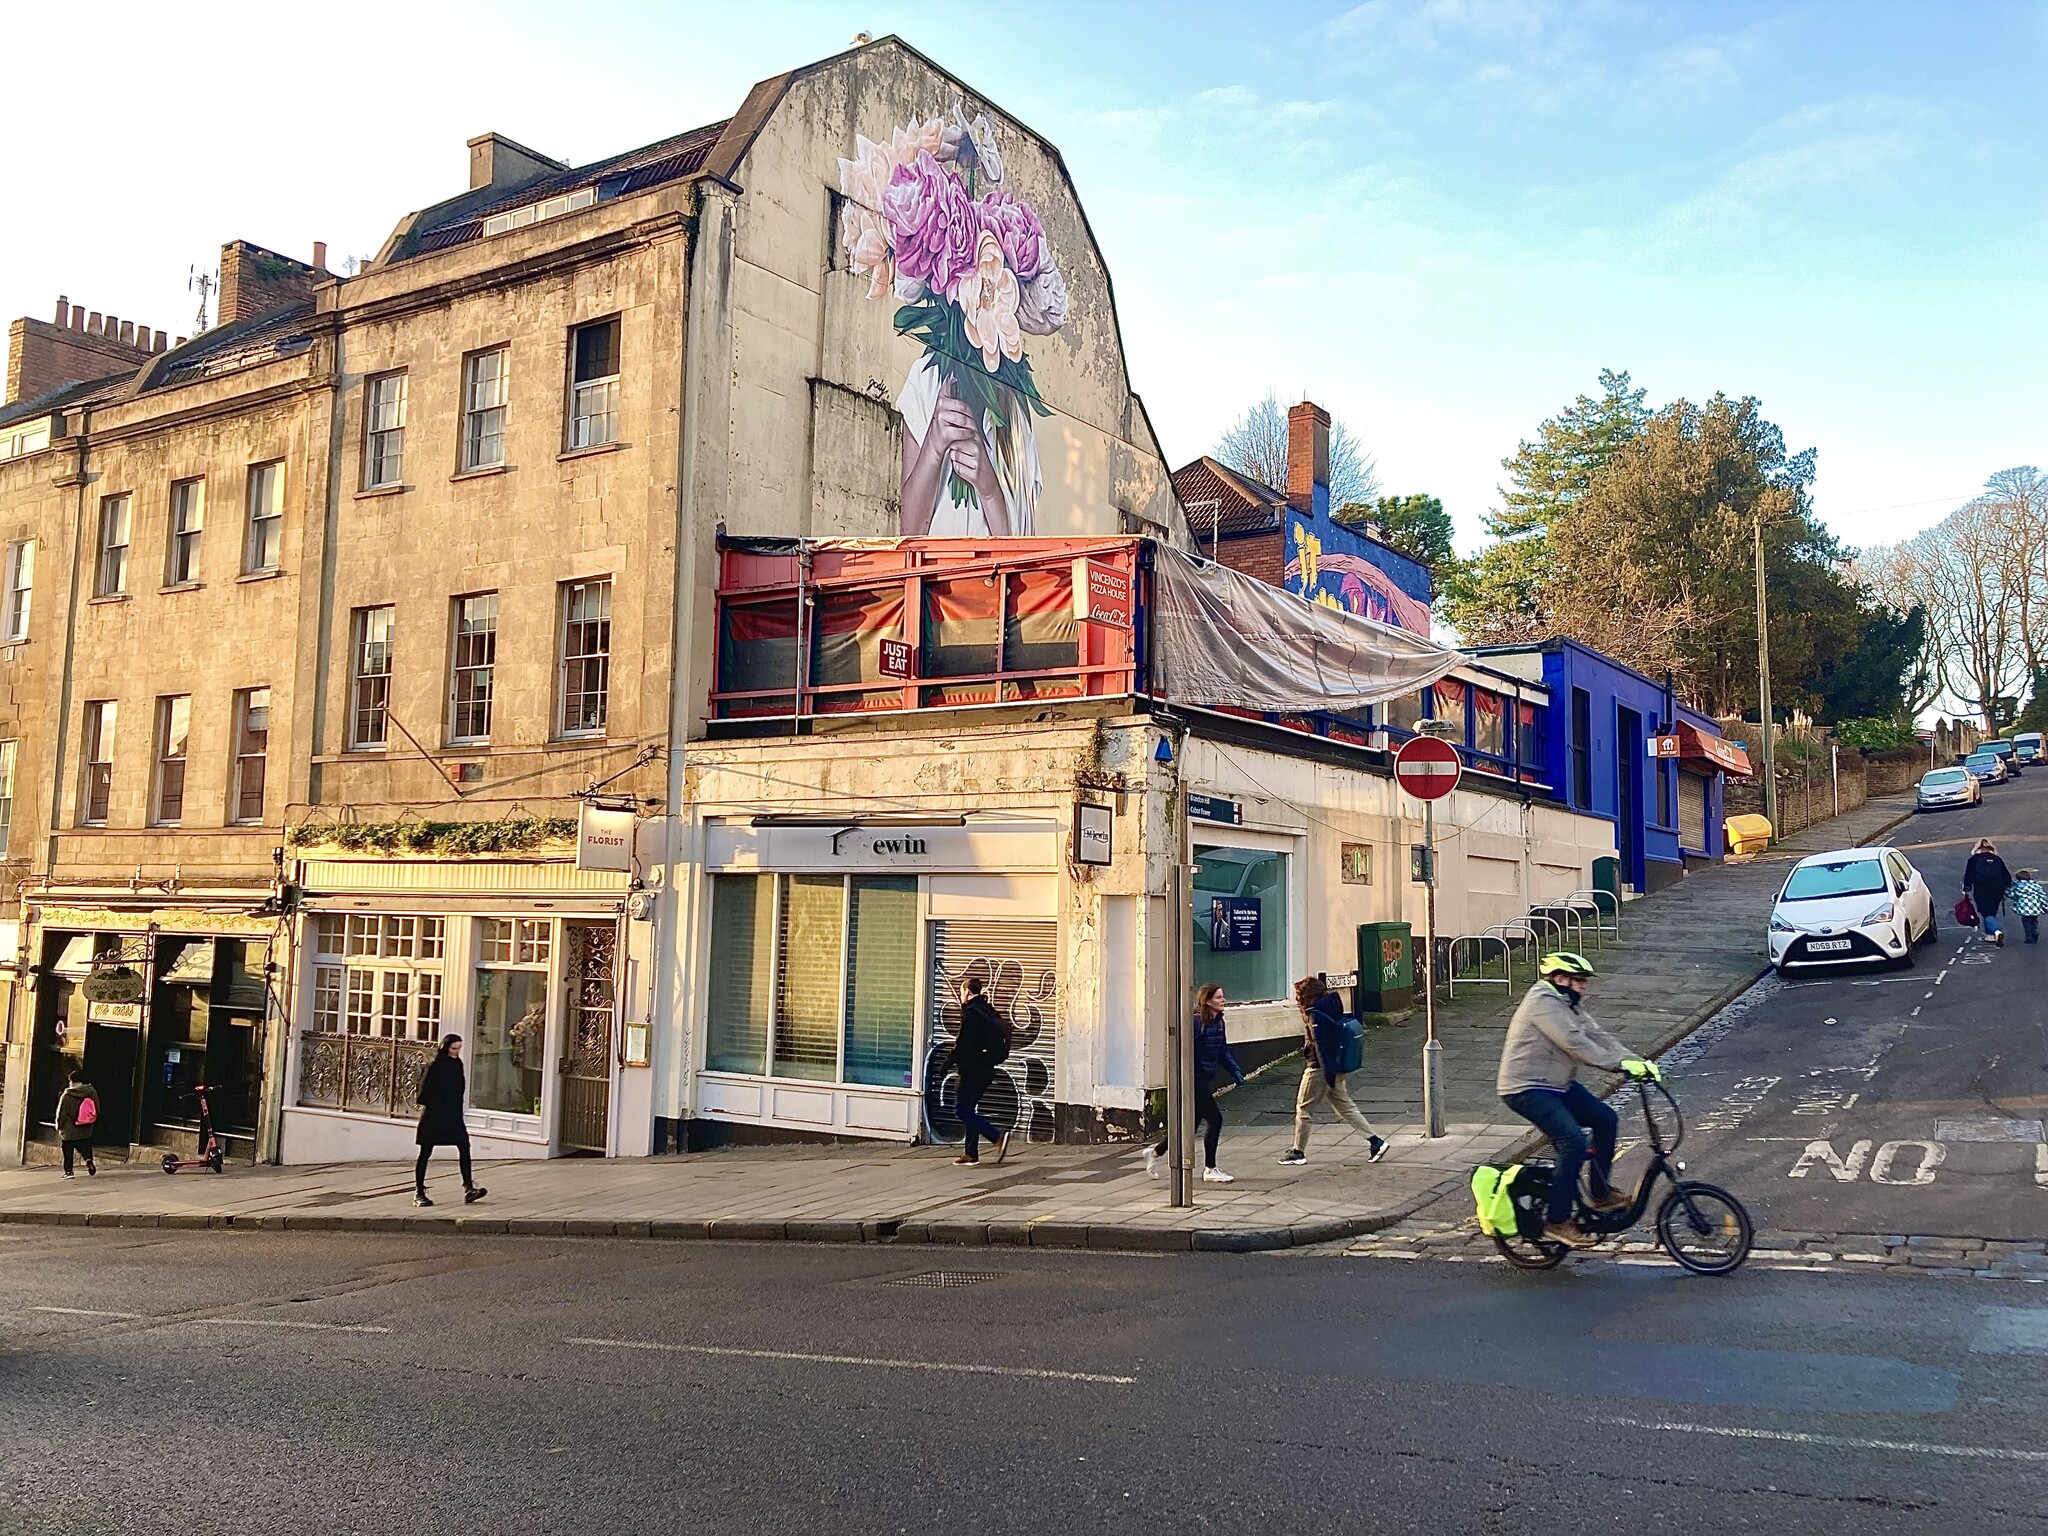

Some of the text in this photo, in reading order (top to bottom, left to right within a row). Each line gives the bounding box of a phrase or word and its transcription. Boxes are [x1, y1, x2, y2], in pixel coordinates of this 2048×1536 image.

[1089, 569, 1127, 590] VINCENZO'S
[1090, 582, 1127, 601] PIZZA HOUSE
[1090, 603, 1127, 625] Coca-Cl
[883, 642, 908, 658] JUST
[889, 656, 908, 671] EAT
[1200, 808, 1211, 817] Tower
[587, 836, 625, 846] FLORIST
[872, 833, 928, 855] ewin
[1831, 940, 1848, 949] RTZ
